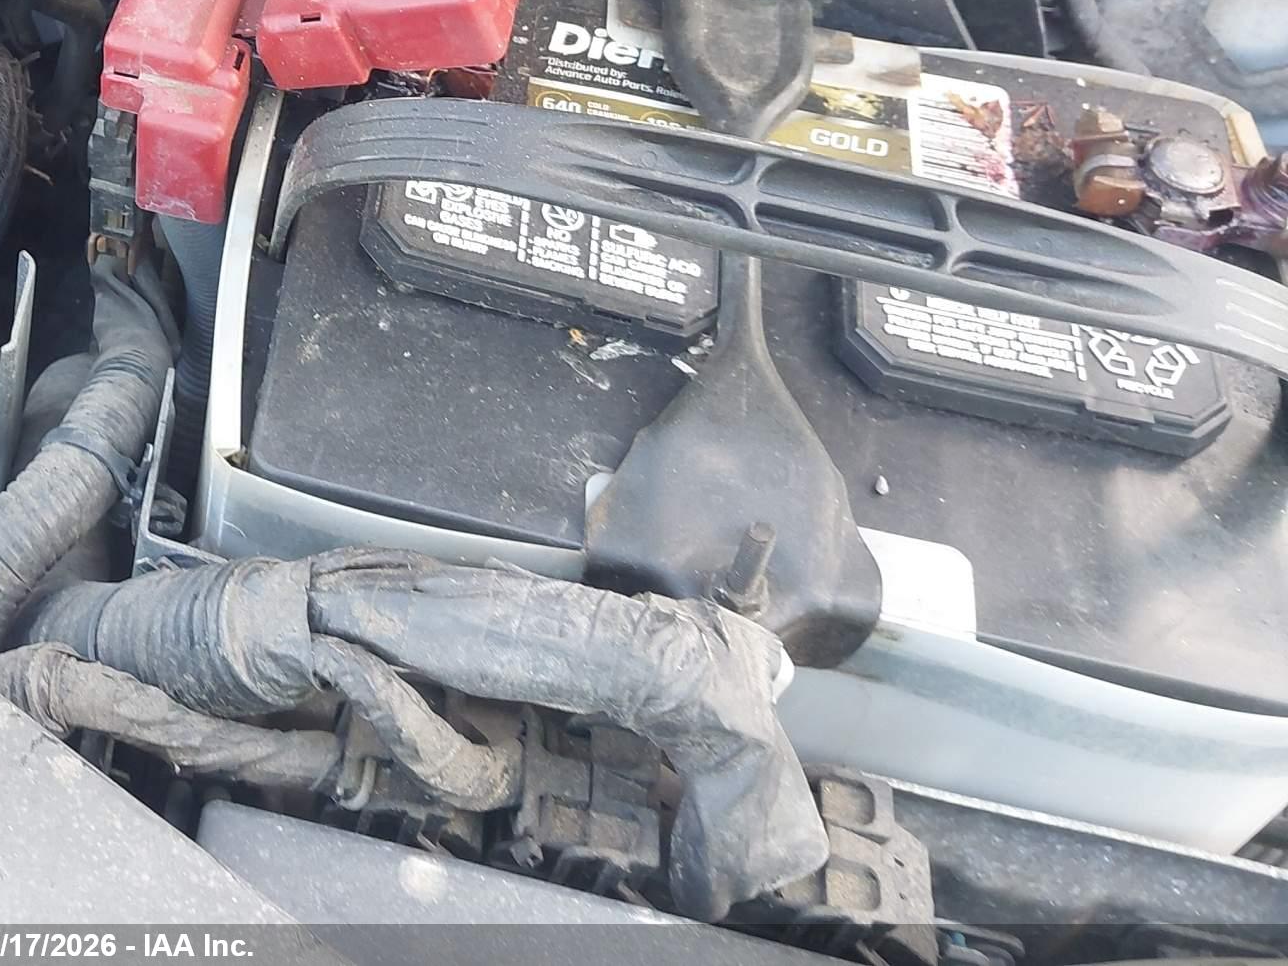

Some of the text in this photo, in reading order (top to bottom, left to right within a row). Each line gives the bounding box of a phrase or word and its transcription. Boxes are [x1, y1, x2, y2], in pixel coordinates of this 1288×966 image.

[545, 65, 593, 82] Advance
[593, 74, 620, 87] Auto
[547, 56, 609, 76] Distributed
[810, 128, 889, 157] GOLD
[441, 197, 513, 227] EXPLOSIVE
[474, 195, 510, 214] EYES
[440, 210, 484, 232] GASES
[546, 225, 572, 243] NO
